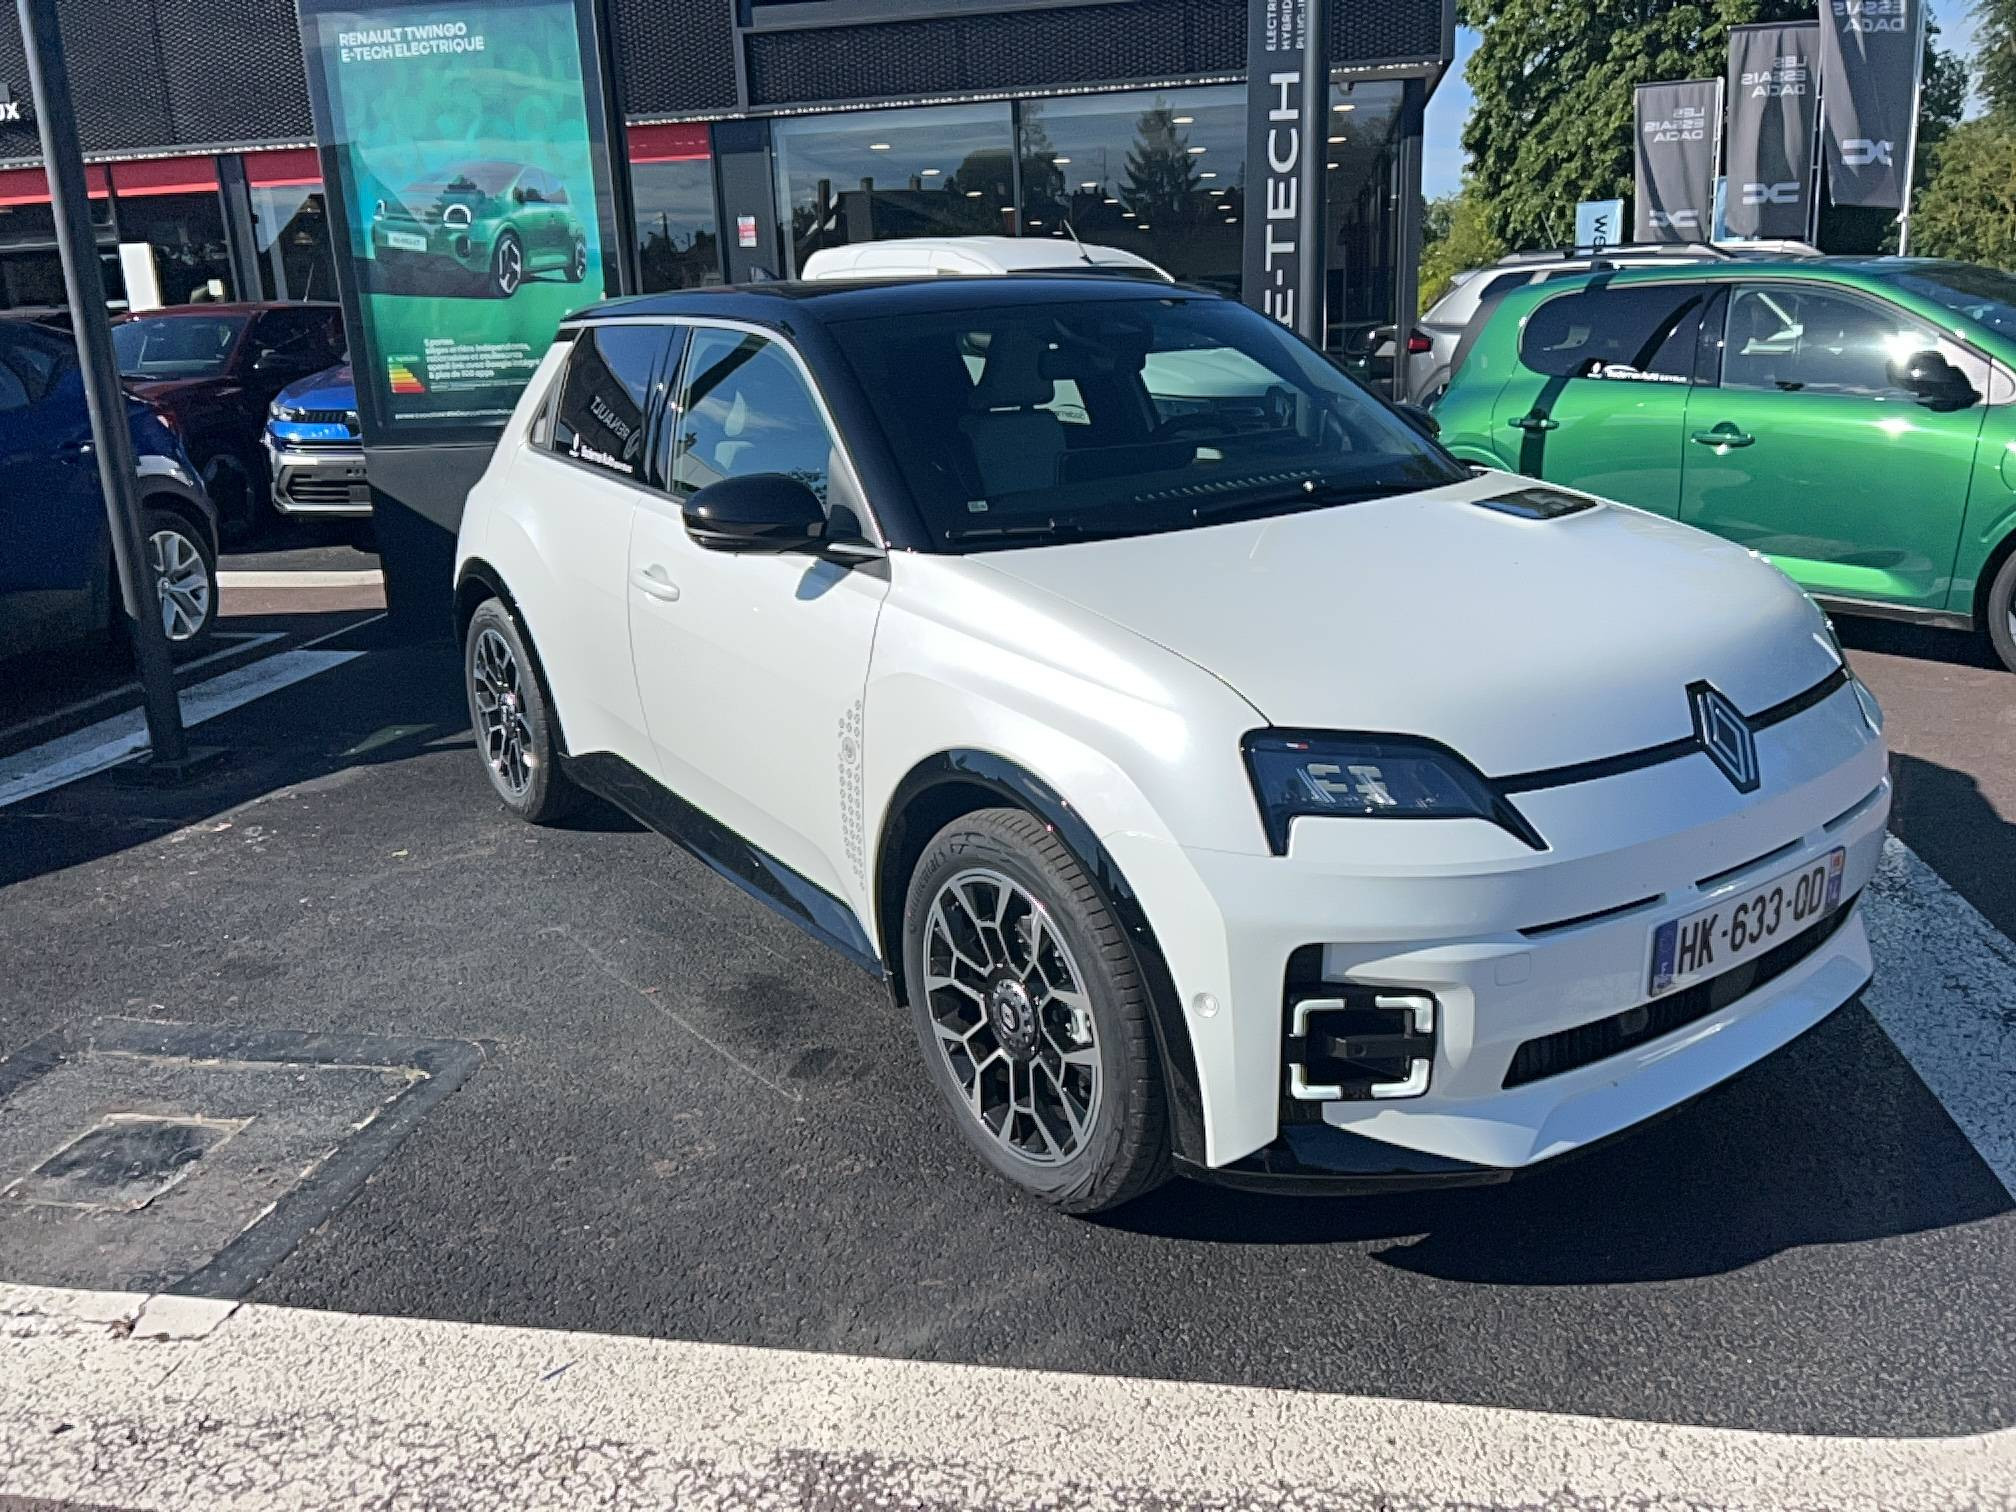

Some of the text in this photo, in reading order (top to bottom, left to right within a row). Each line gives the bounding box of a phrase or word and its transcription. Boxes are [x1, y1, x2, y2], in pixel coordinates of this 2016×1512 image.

[338, 22, 467, 47] RENAULT TWINGO
[341, 36, 485, 63] E-TECH ELECTRIQUE
[1264, 71, 1300, 328] E-TECH
